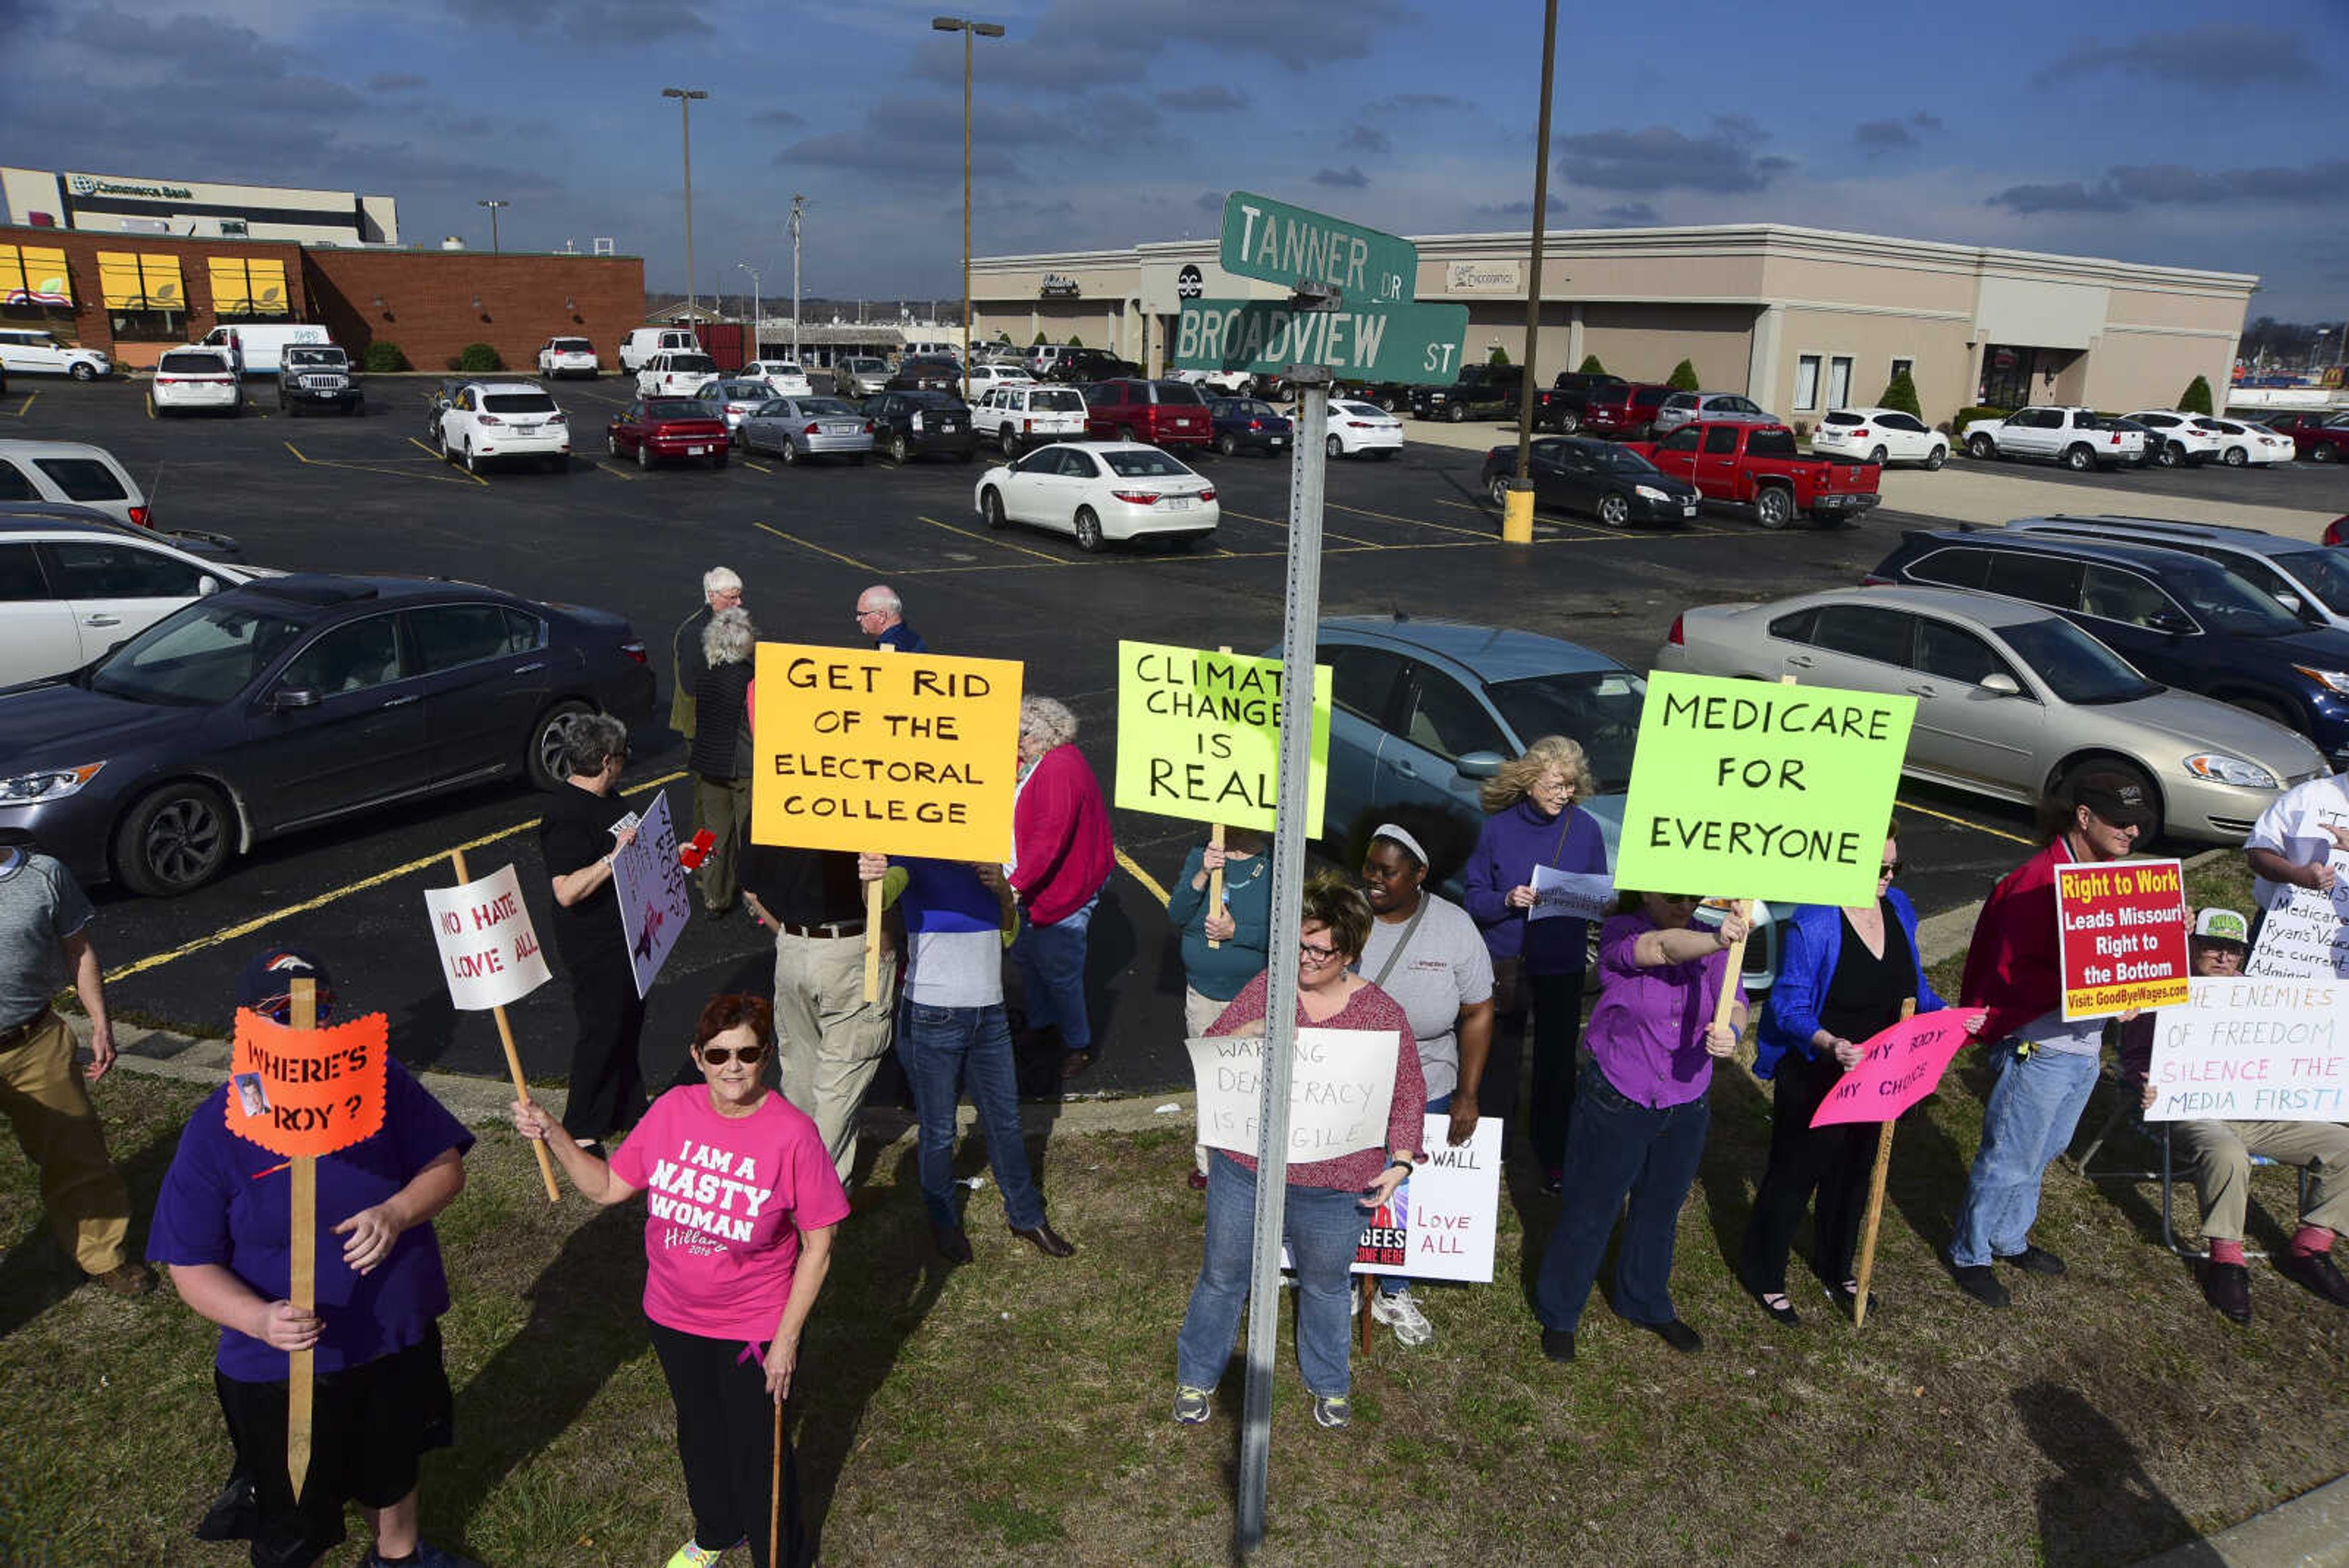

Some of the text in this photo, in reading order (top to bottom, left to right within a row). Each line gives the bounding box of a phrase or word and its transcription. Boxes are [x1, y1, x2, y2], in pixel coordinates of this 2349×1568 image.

[1242, 204, 1401, 300] TANNER DR
[1178, 308, 1456, 373] BROADVIEW ST
[787, 658, 990, 696] GET RID
[1137, 655, 1283, 697] CLIMAT
[1147, 690, 1282, 727] CHANGE
[1663, 693, 1891, 740] MEDICARE
[814, 710, 959, 740] OF THE
[1198, 734, 1231, 759] IS
[775, 754, 983, 784] ELECTORAL
[1150, 758, 1277, 809] REAL
[1718, 757, 1806, 790] FOR
[784, 795, 966, 823] COLLEGE
[1650, 817, 1860, 864] EVERYONE
[2061, 869, 2180, 904] Right to Work
[441, 892, 518, 935] NO HATE
[2065, 909, 2115, 931] Leads
[2118, 904, 2181, 926] Missouri
[451, 931, 538, 978] LOVE ALL
[2096, 933, 2158, 959] Right to
[2258, 942, 2348, 971] the current
[2084, 960, 2172, 985] the Bottom
[2068, 984, 2188, 1009] Visit: GoodByeWages.com
[2231, 985, 2338, 1009] ENEMIES
[1866, 1029, 1948, 1061] MY BODY
[2168, 1018, 2334, 1049] OF FREEDOM
[248, 1039, 366, 1083] WHERE'S
[2160, 1057, 2345, 1083] SILENCE THE
[1836, 1061, 1928, 1101] MY CHOICE
[275, 1104, 333, 1131] ROY
[2167, 1092, 2235, 1114] MEDIA
[1214, 1111, 1364, 1148] IS FGILE
[680, 1140, 756, 1181] I AM A
[1431, 1151, 1480, 1170] WALL
[648, 1159, 771, 1217] NASTY
[651, 1193, 754, 1243] WOMAN
[1417, 1205, 1471, 1229] LOVE
[665, 1227, 728, 1252] Hillary
[1361, 1228, 1405, 1248] GEES
[1421, 1235, 1464, 1254] ALL
[1381, 1248, 1404, 1265] HERE
